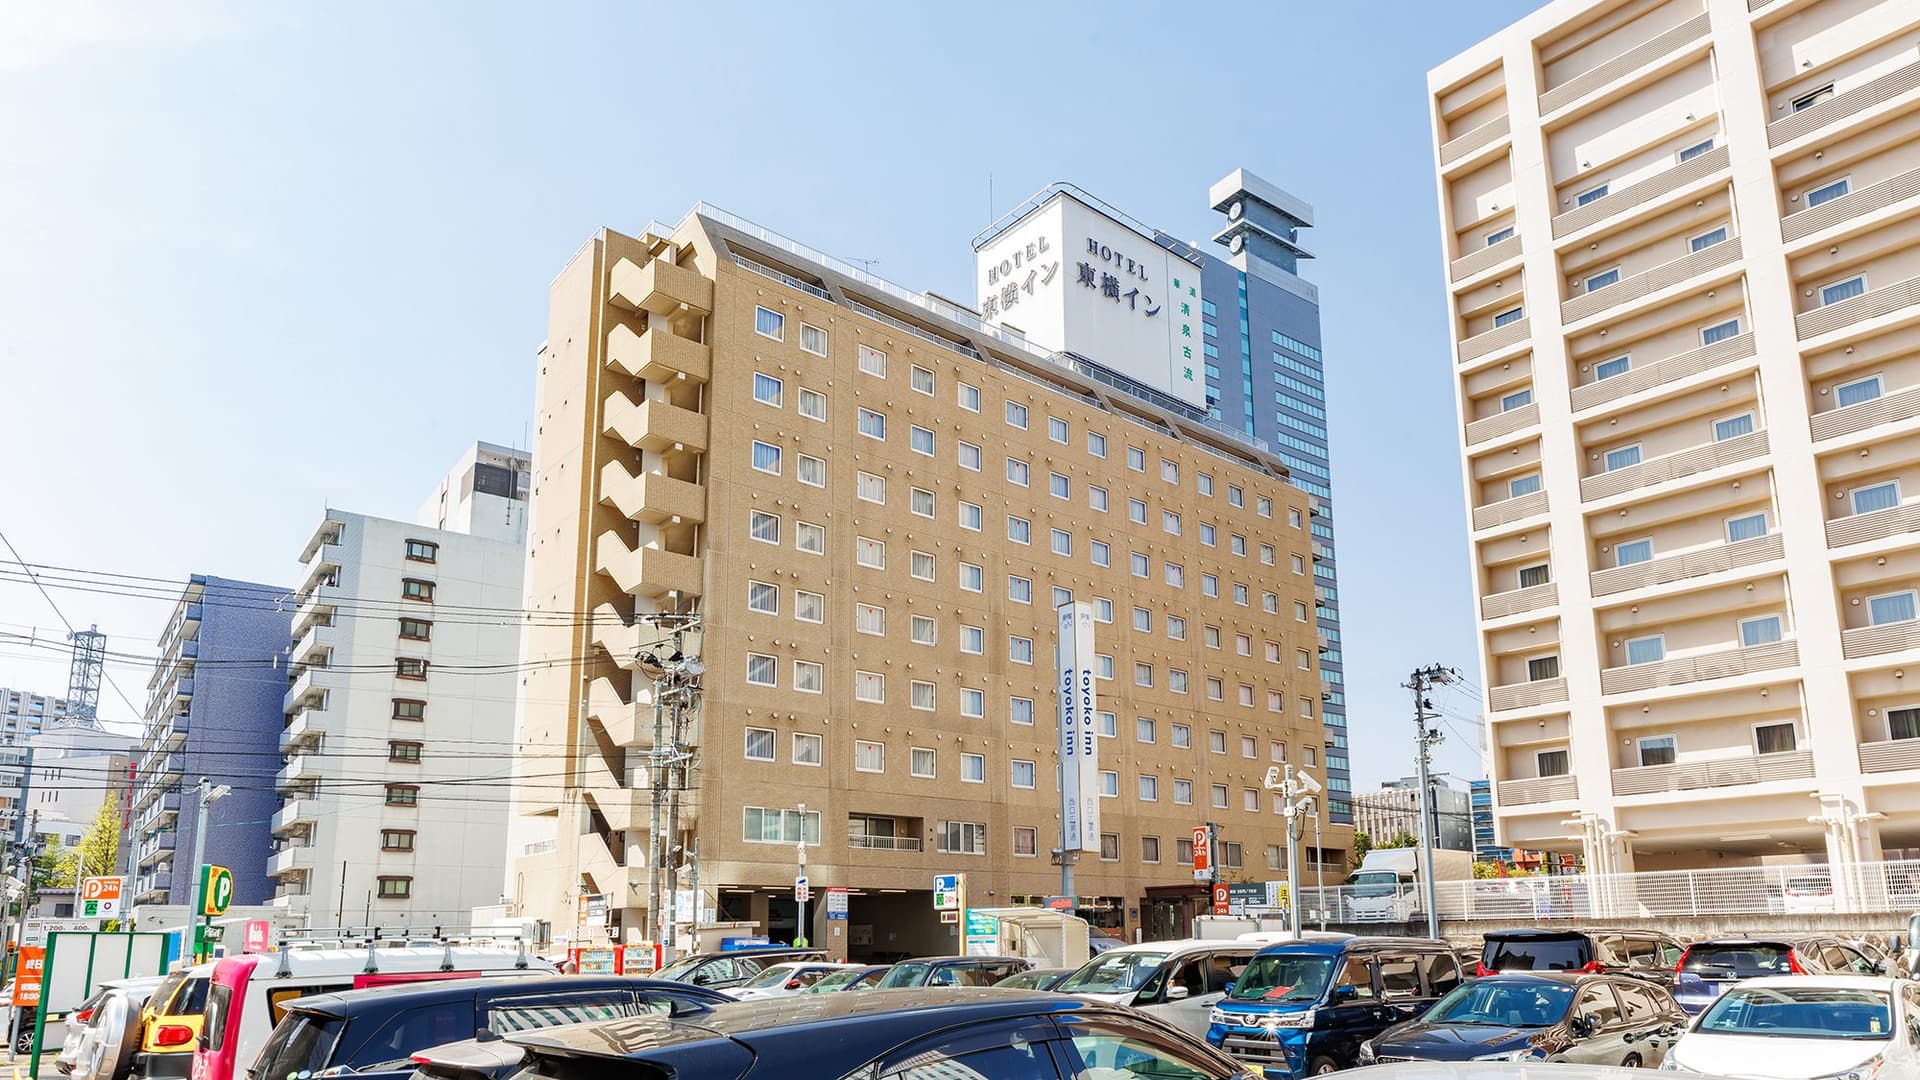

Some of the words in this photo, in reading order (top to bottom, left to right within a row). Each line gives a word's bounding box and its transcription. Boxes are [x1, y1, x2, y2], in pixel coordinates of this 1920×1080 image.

[988, 236, 1050, 286] HOTEL
[1087, 237, 1148, 281] HOTEL
[981, 261, 1059, 321] 東横イン
[1076, 261, 1161, 317] 東横イン
[1063, 668, 1074, 725] toyoko
[1081, 669, 1093, 725] toyoko
[1066, 730, 1075, 755] inn
[1084, 731, 1094, 755] inn
[103, 884, 119, 892] 24h
[217, 877, 230, 907] P
[936, 878, 945, 893] P
